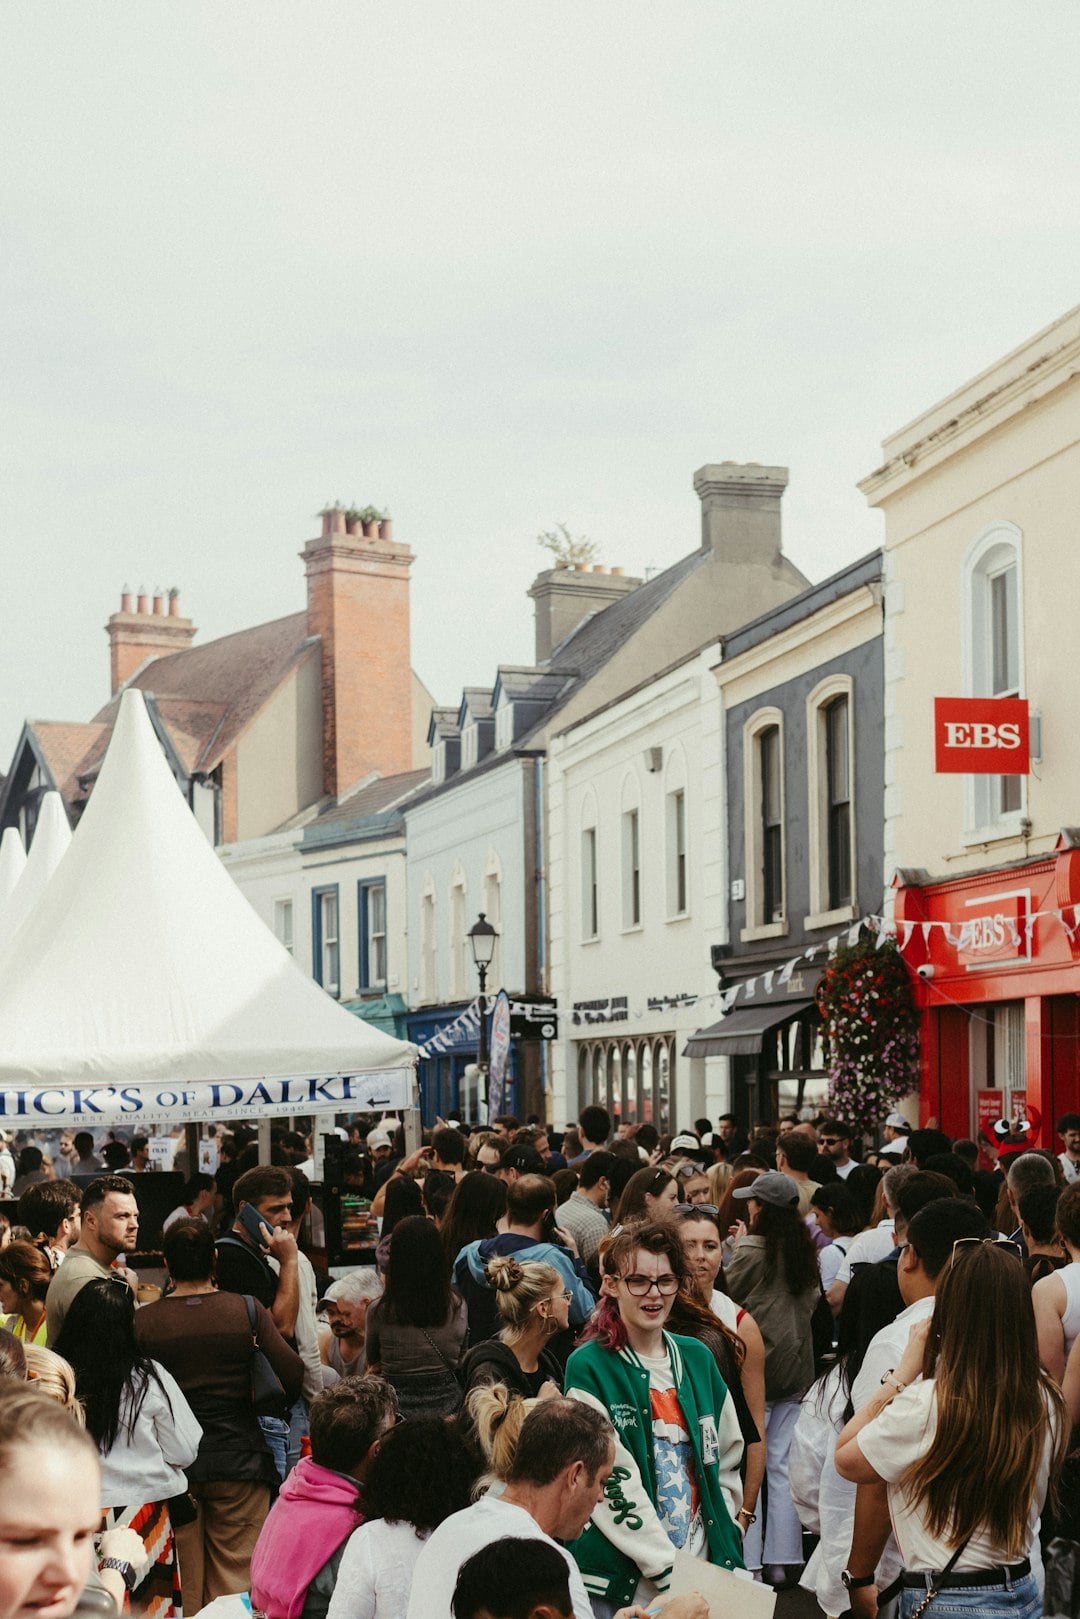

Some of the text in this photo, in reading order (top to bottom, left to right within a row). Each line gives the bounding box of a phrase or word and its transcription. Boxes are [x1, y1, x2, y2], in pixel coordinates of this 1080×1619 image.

[943, 722, 1021, 749] EBS
[970, 913, 1005, 950] EBS
[156, 1090, 196, 1107] OF
[115, 1112, 171, 1121] QUALITY
[182, 1110, 216, 1118] MEAT
[227, 1106, 265, 1115] SINCE
